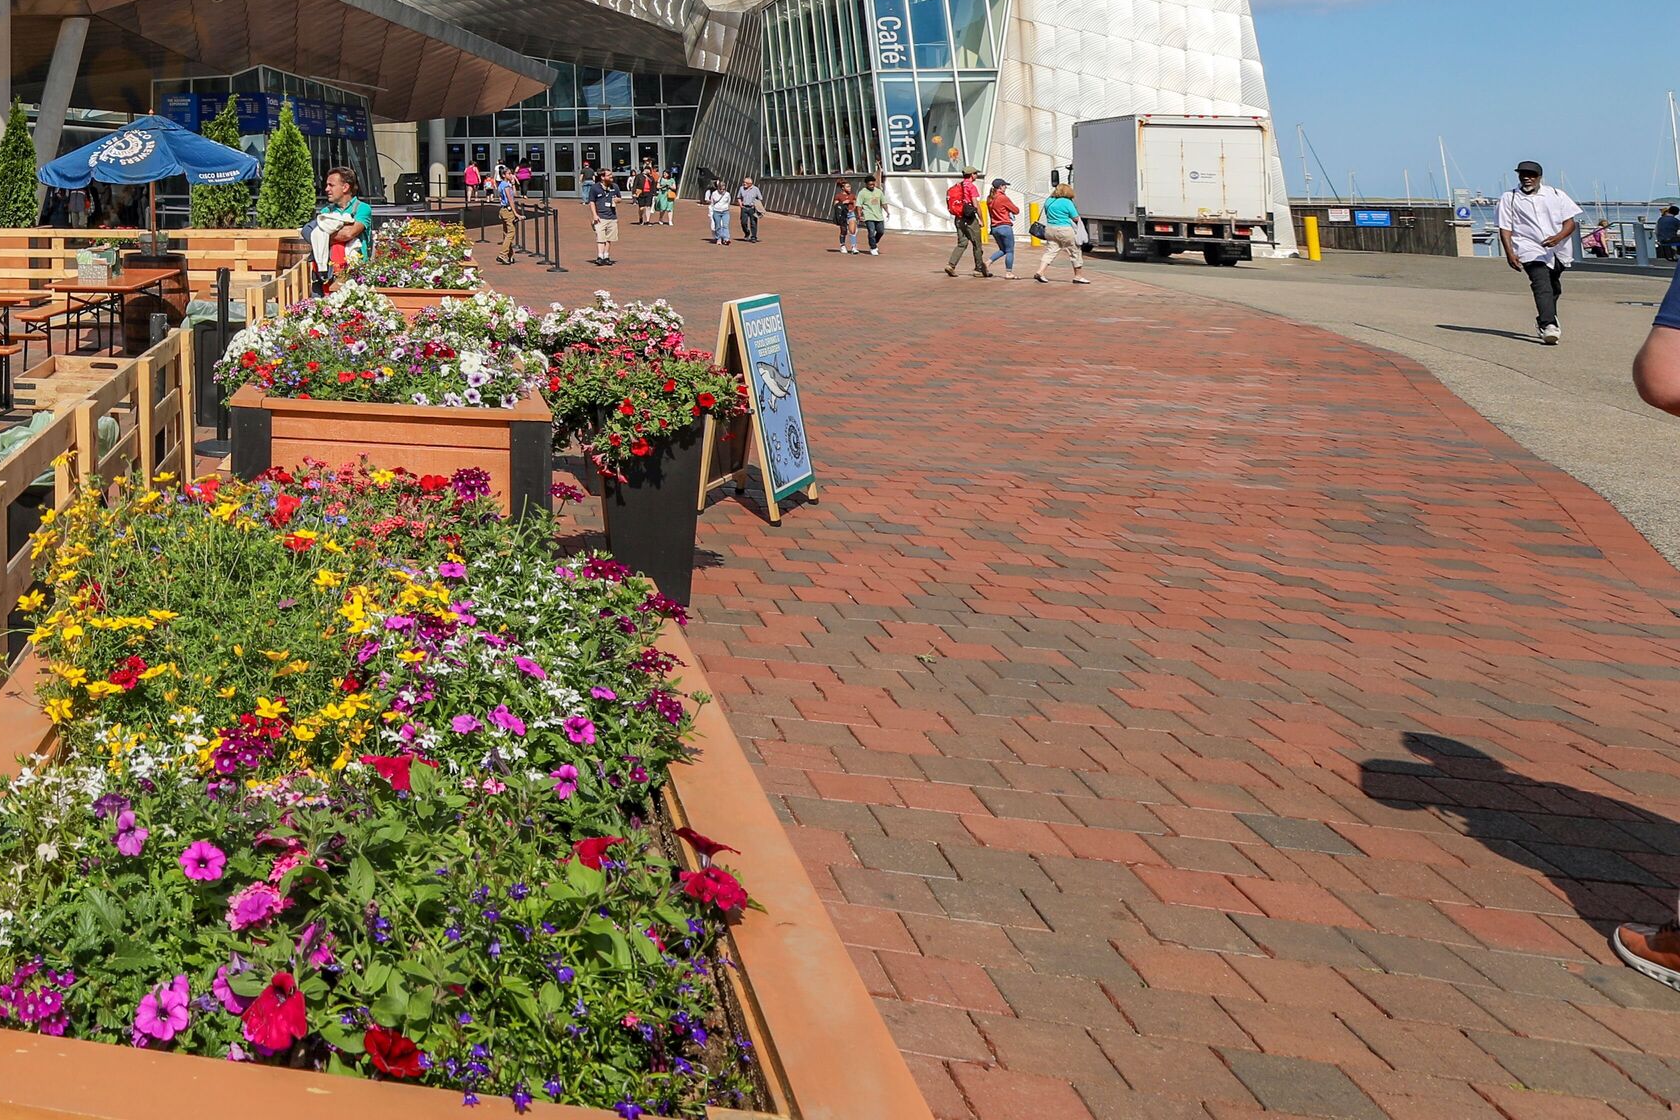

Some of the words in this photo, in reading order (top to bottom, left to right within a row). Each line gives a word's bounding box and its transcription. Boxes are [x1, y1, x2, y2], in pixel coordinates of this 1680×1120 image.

[876, 16, 907, 64] Café
[888, 114, 917, 166] Gifts
[745, 314, 782, 339] DOCKSIDE
